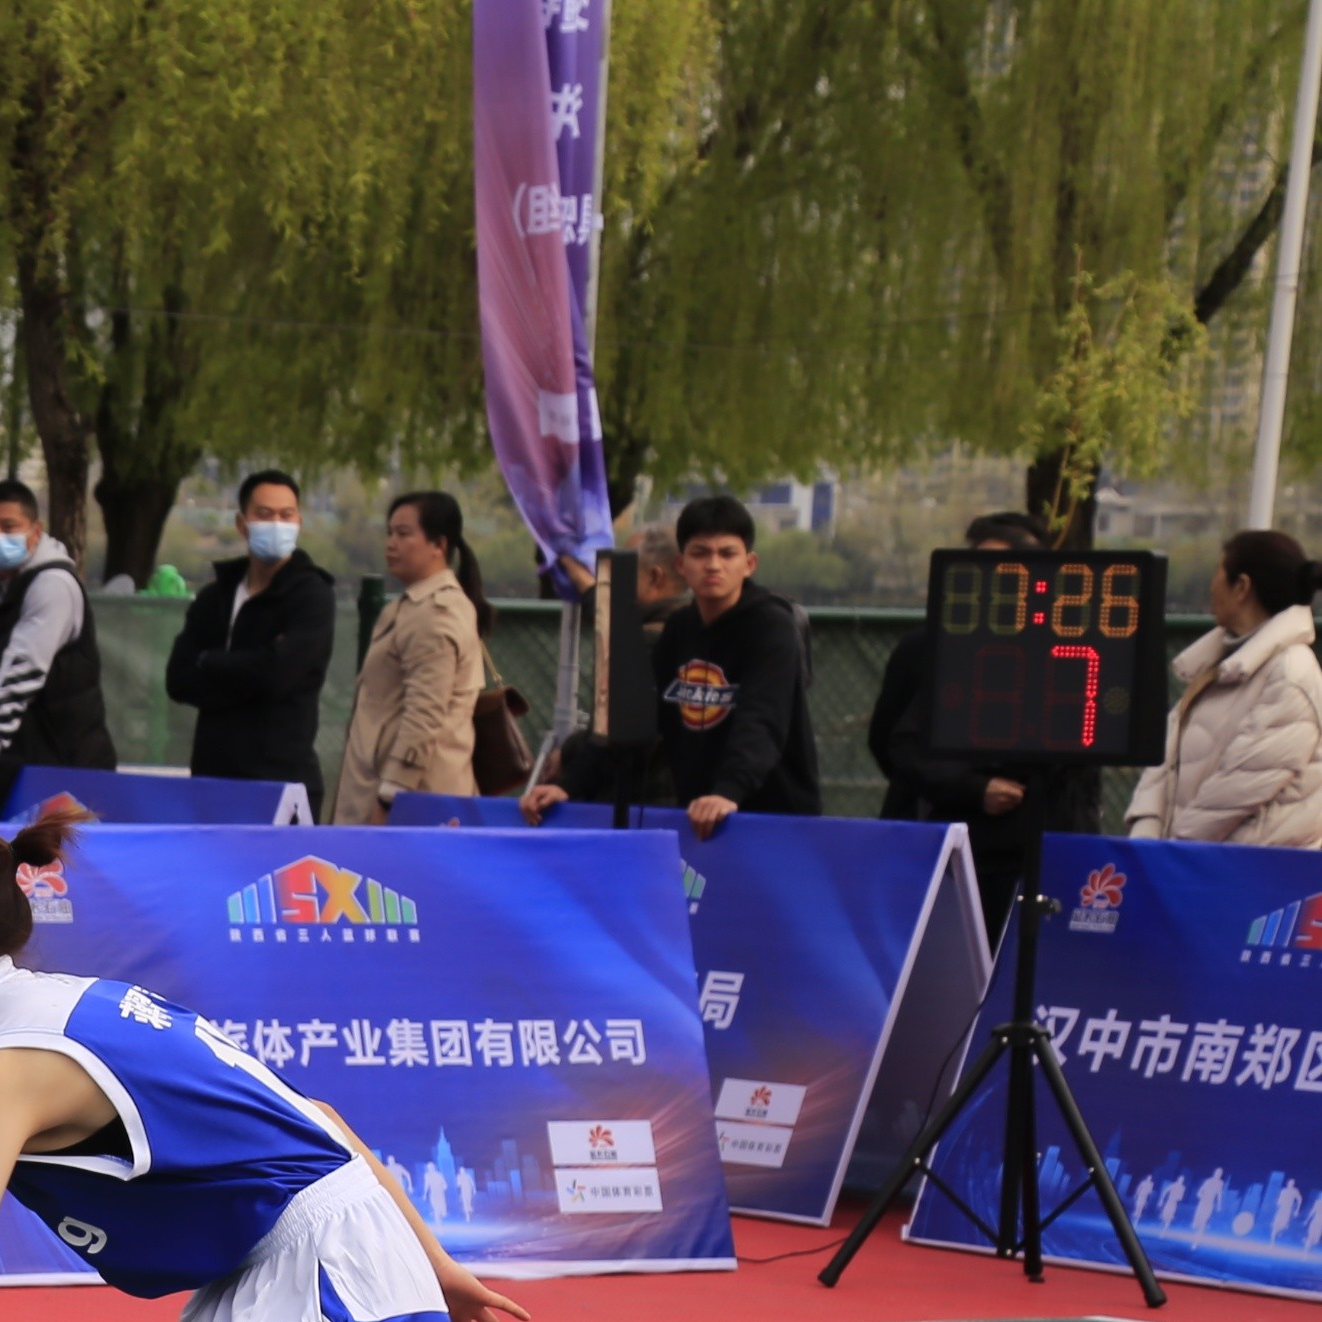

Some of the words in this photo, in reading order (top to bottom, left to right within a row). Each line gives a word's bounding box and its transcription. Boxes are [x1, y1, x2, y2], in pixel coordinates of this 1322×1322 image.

[996, 563, 1140, 638] 7:26
[1051, 645, 1100, 747] 7
[1239, 949, 1322, 968] 陕西省三
